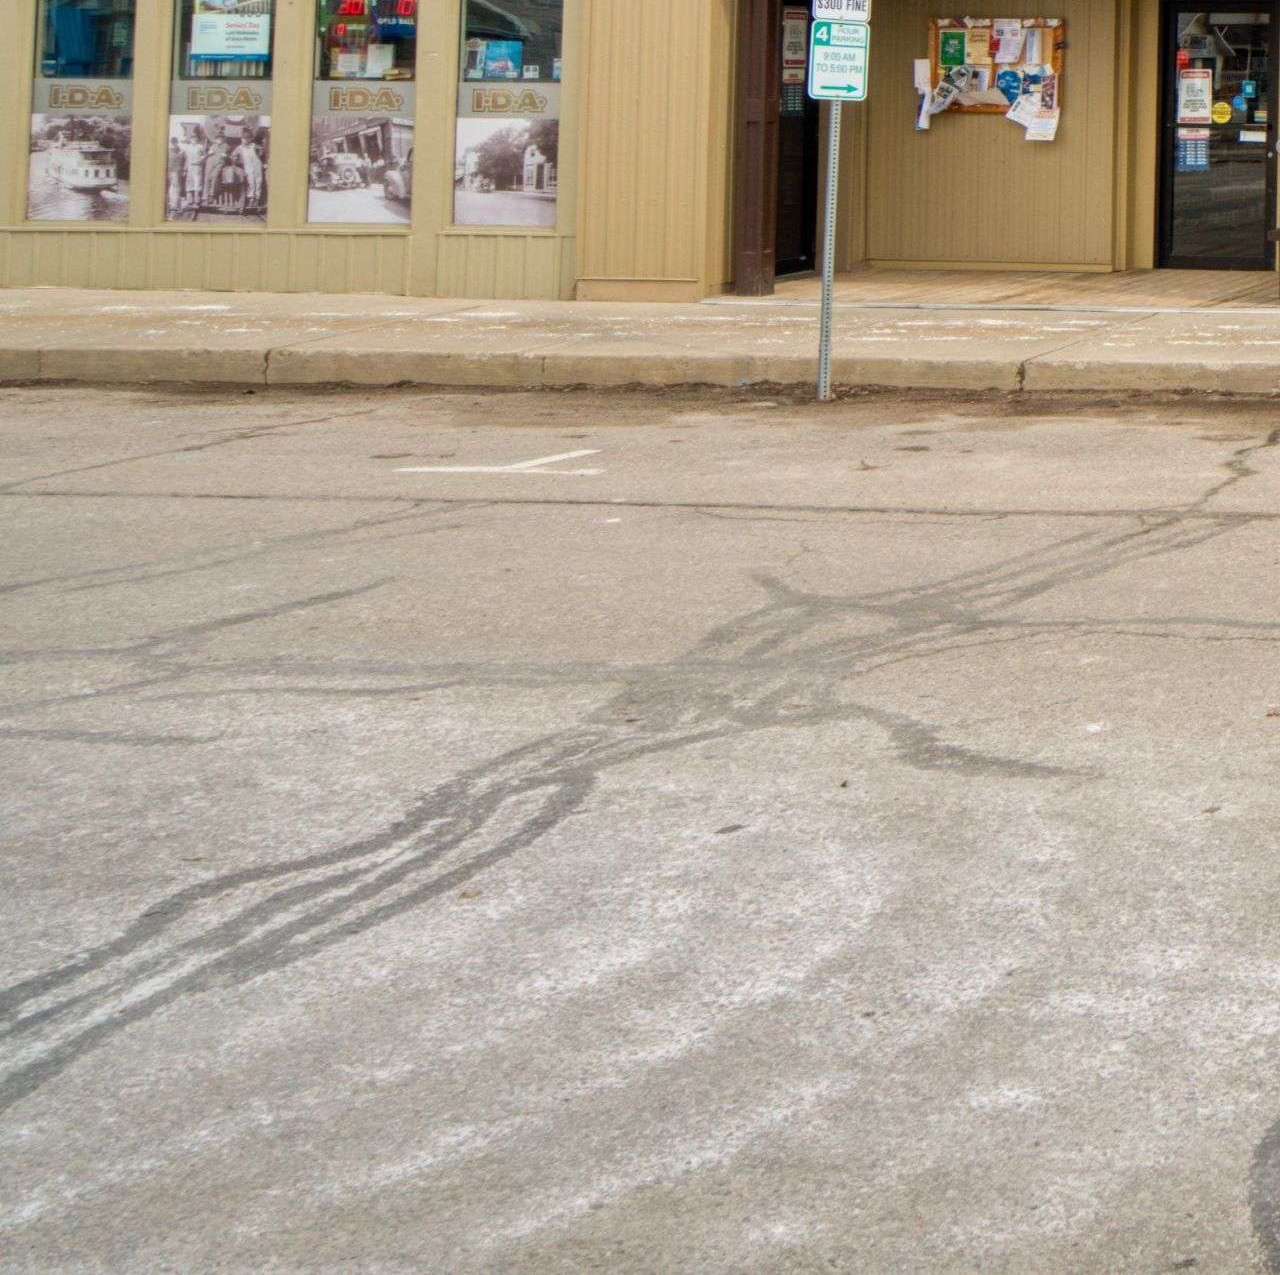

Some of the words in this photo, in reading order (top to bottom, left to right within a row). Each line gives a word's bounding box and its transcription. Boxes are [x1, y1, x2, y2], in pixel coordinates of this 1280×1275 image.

[816, 26, 829, 42] 4
[843, 52, 856, 62] AM
[816, 63, 829, 73] TO
[849, 65, 863, 74] PM
